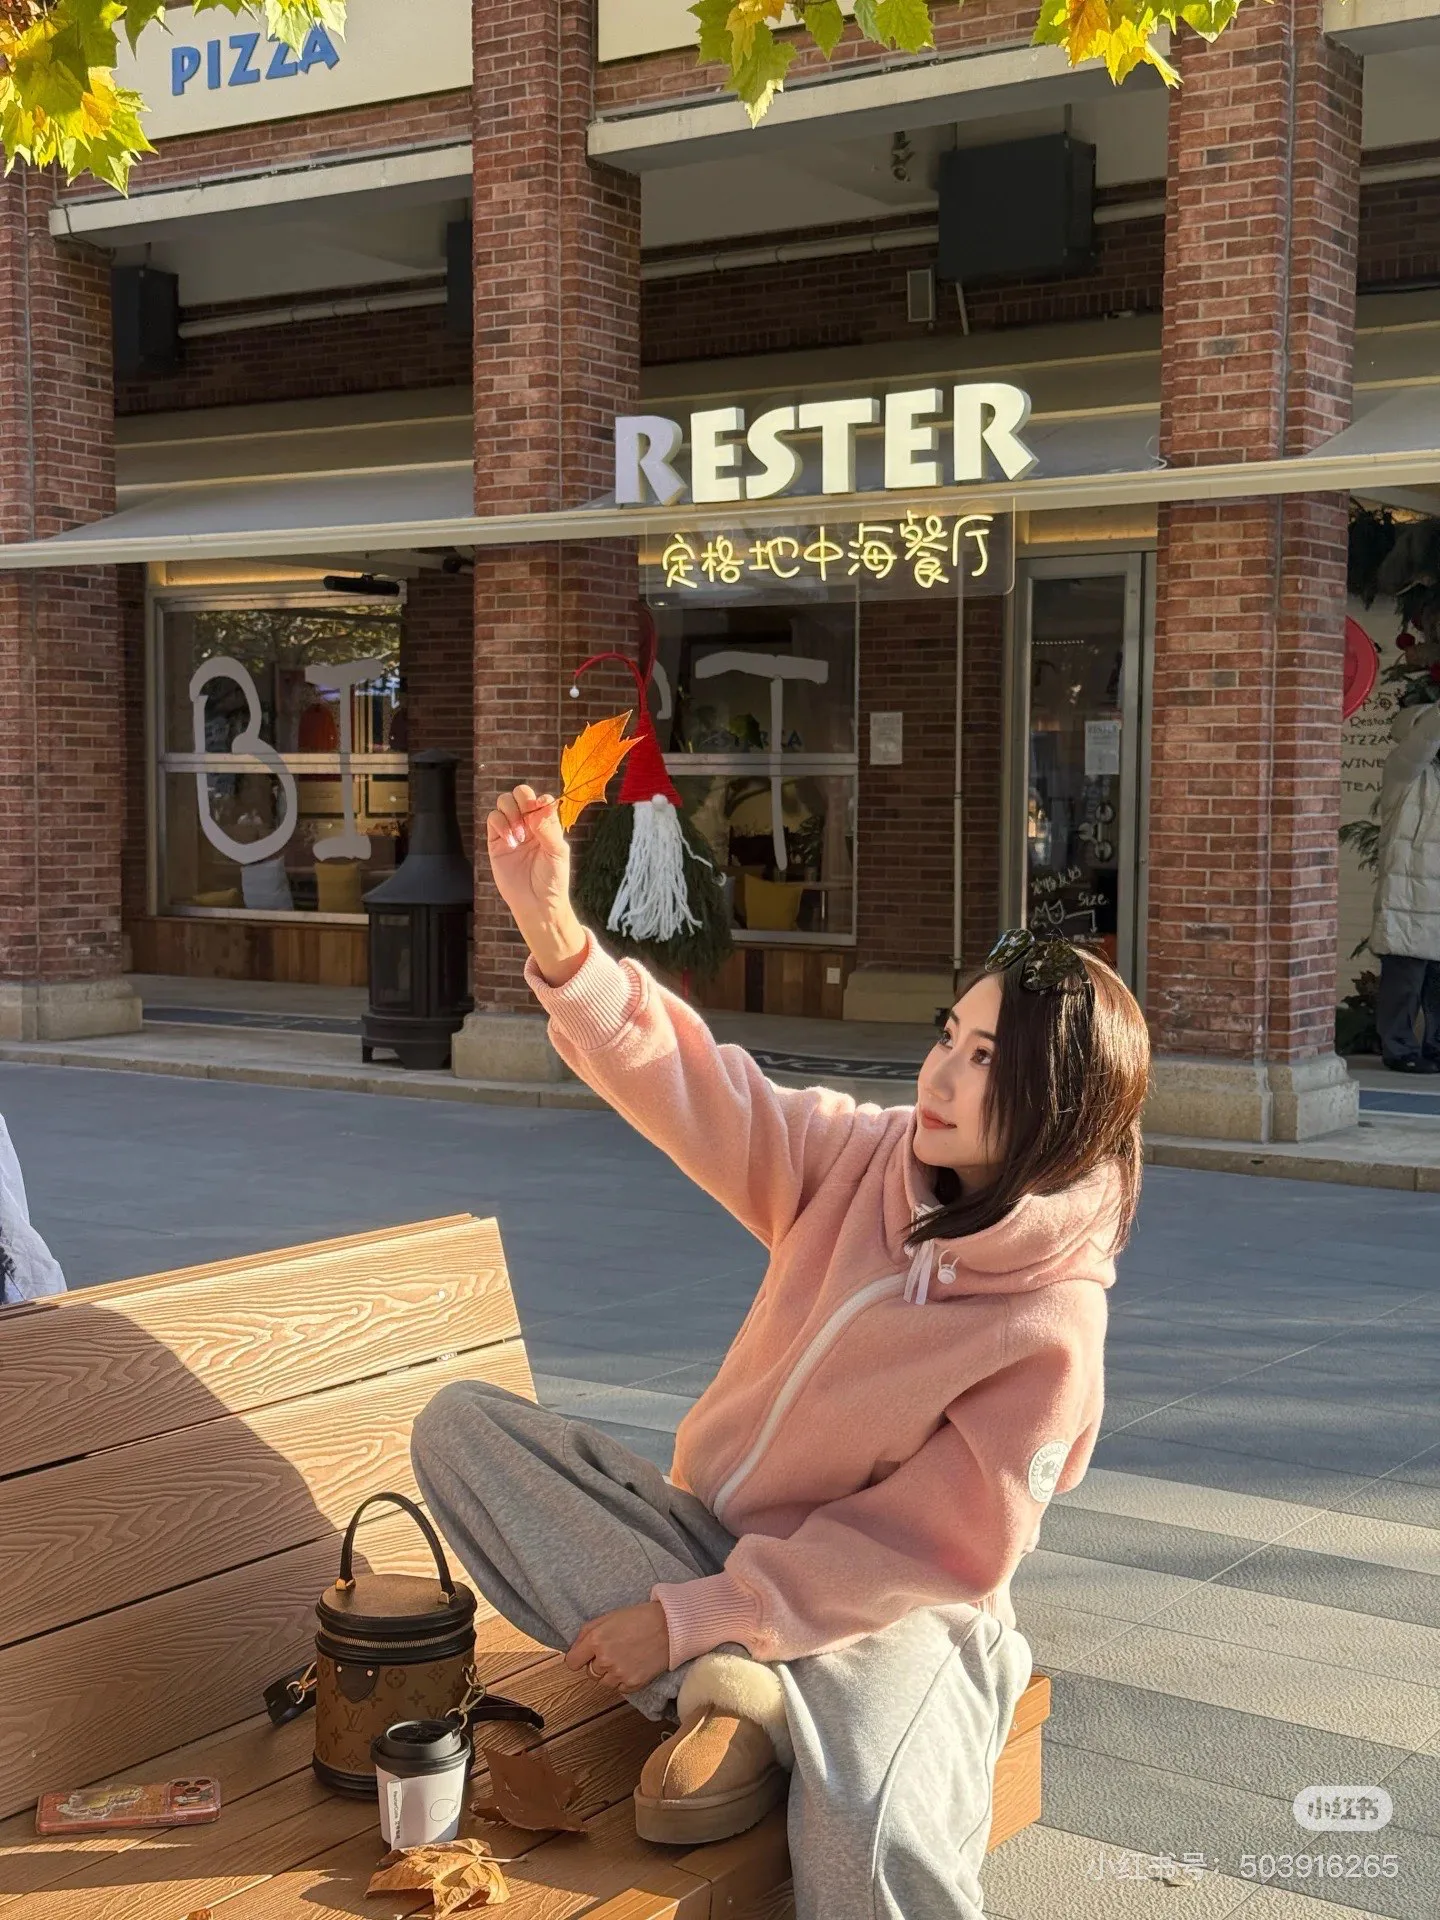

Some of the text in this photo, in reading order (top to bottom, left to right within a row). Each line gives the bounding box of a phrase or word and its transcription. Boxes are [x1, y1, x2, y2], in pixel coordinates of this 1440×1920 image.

[171, 21, 340, 97] PIZZA
[614, 382, 1041, 507] RESTER
[662, 510, 994, 589] 定格地中海餐厅
